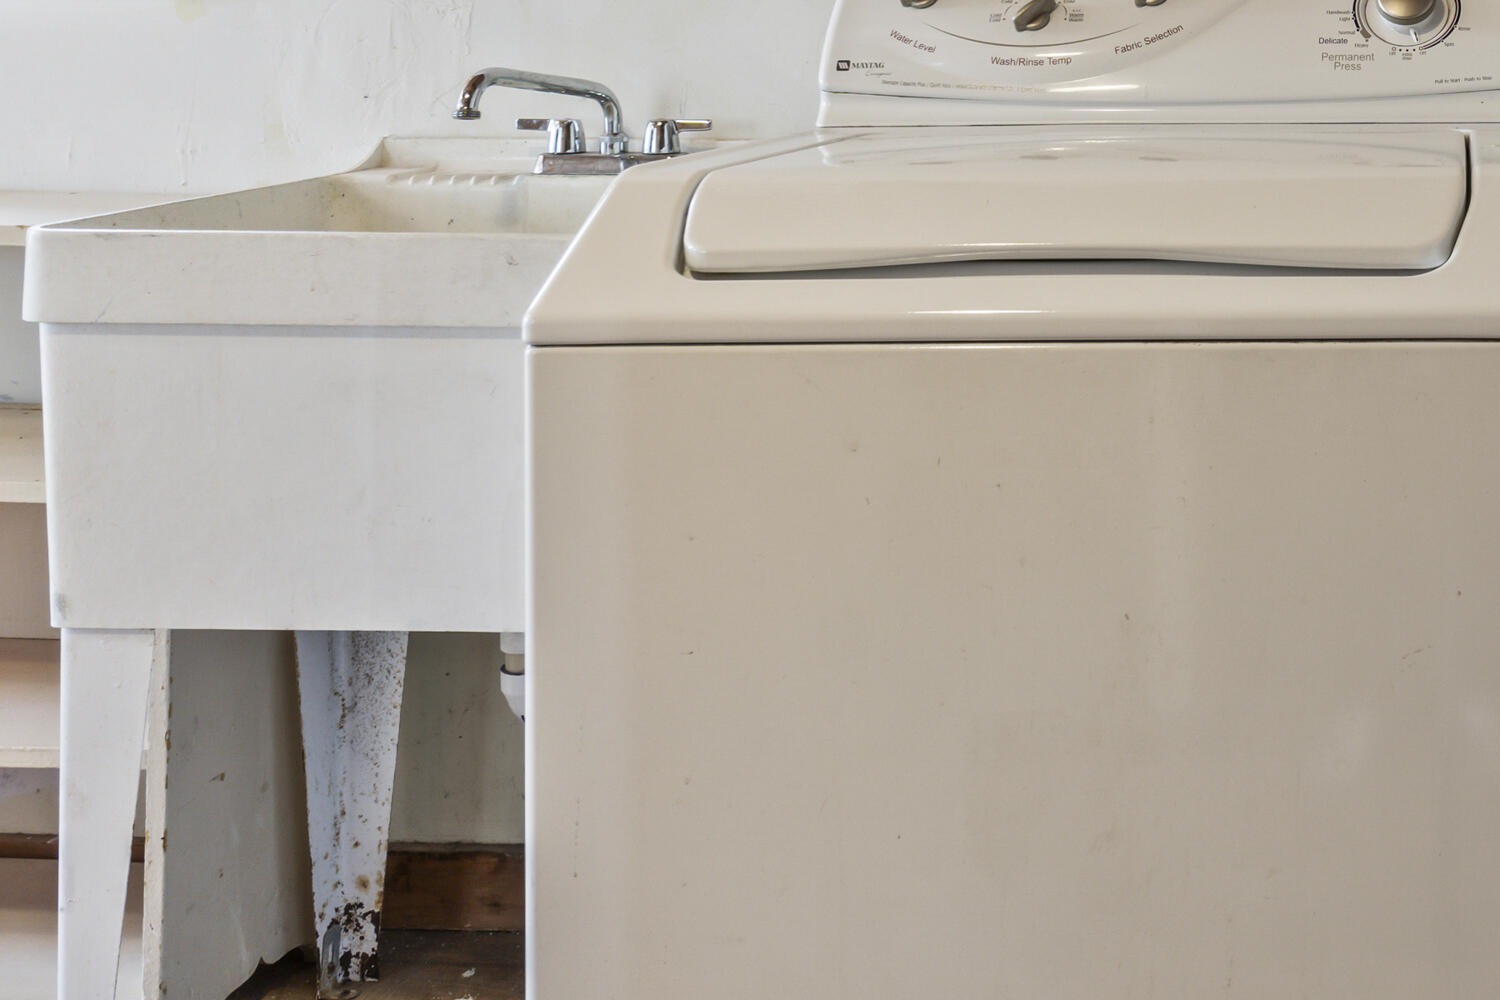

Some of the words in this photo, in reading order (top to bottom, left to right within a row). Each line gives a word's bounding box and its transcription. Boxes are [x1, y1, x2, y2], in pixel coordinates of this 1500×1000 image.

[890, 29, 913, 47] Water
[913, 40, 937, 54] Level
[1114, 40, 1143, 55] Fabric
[1143, 24, 1185, 45] Selection
[1318, 37, 1349, 45] Delicate
[990, 56, 1045, 66] Wash/Rinse
[1046, 55, 1073, 66] Temp
[1321, 52, 1375, 62] Permanent
[1333, 61, 1362, 71] Press
